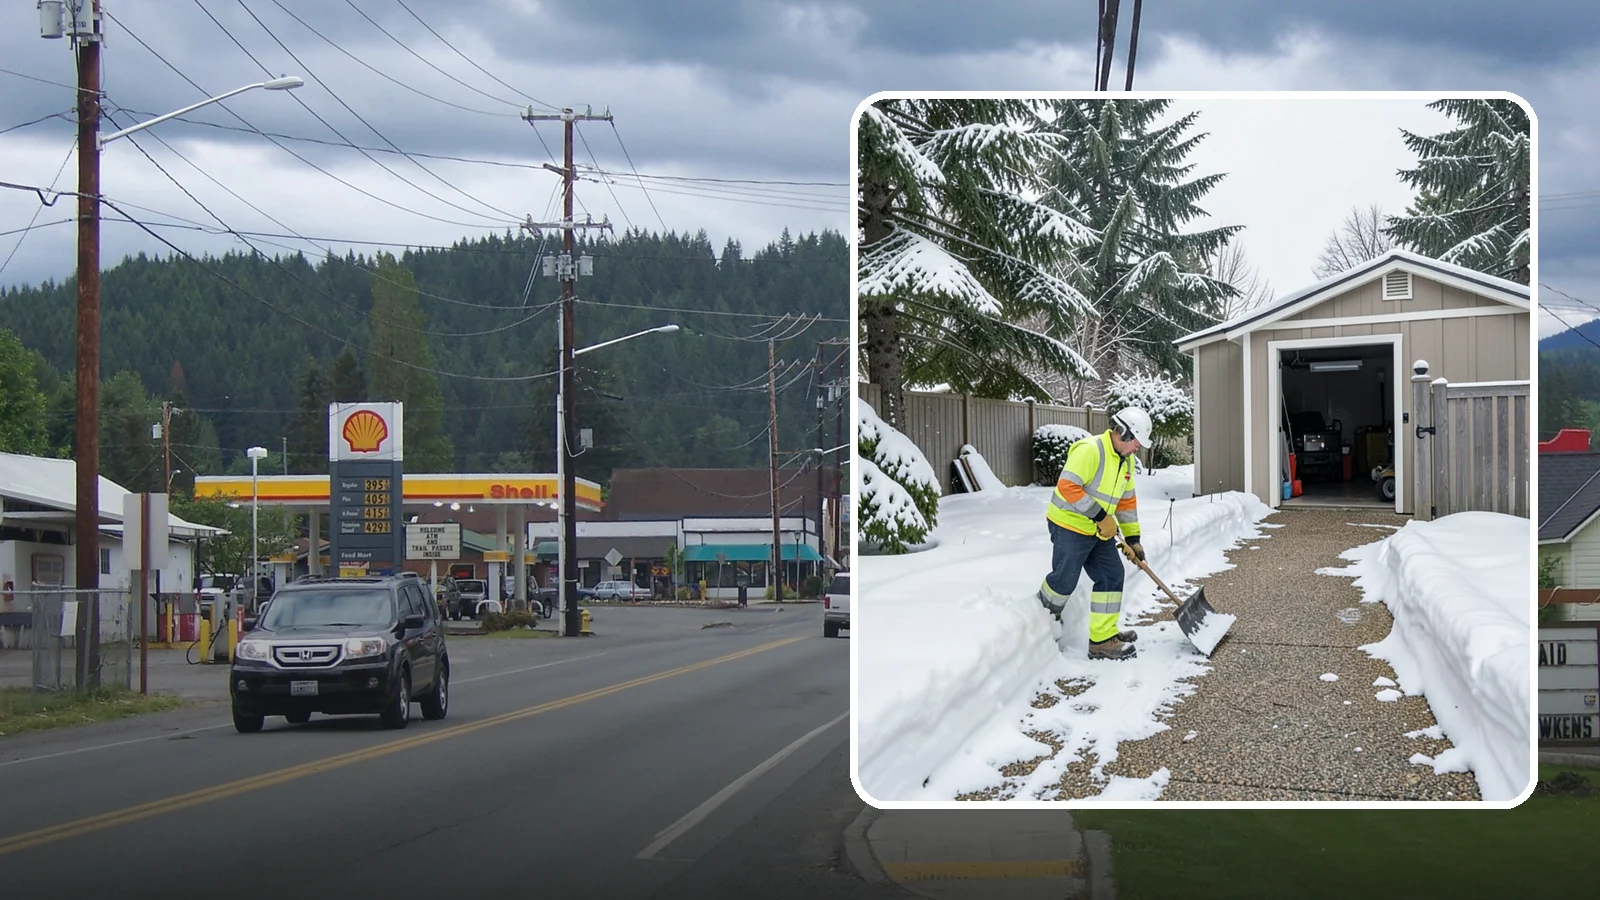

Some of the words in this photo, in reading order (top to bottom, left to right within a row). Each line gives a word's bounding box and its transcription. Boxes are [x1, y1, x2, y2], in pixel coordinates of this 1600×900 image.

[365, 480, 383, 490] 395
[490, 484, 547, 499] Shell
[365, 494, 383, 504] 405
[365, 508, 383, 518] 415
[365, 522, 383, 532] 429
[1538, 643, 1566, 665] AID
